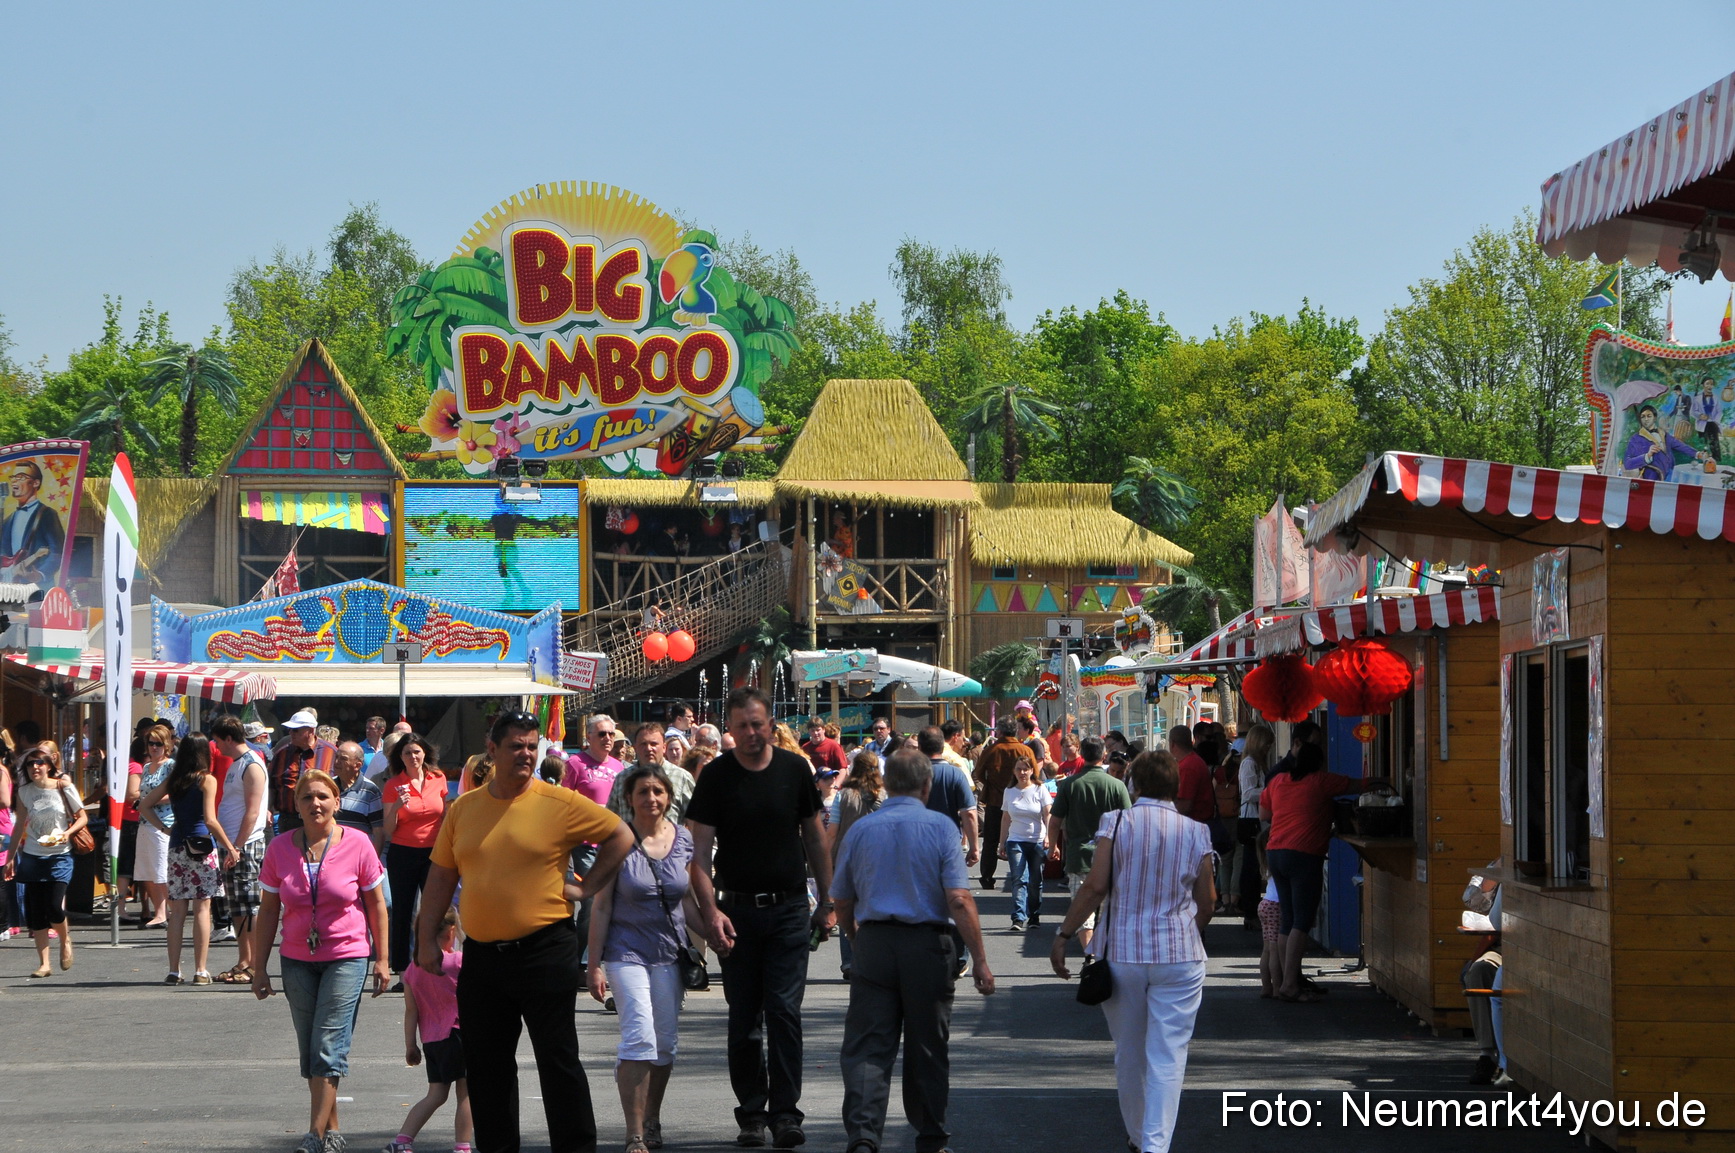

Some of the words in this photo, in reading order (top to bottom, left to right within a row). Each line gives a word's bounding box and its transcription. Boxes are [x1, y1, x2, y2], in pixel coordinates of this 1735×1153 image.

[511, 228, 644, 325] BIG
[460, 331, 731, 412] BAMBOO
[534, 423, 580, 452] it's
[589, 408, 656, 451] fun!
[564, 672, 591, 684] PROBLEM
[568, 667, 592, 676] T-SHIRT
[570, 659, 592, 669] SHOES
